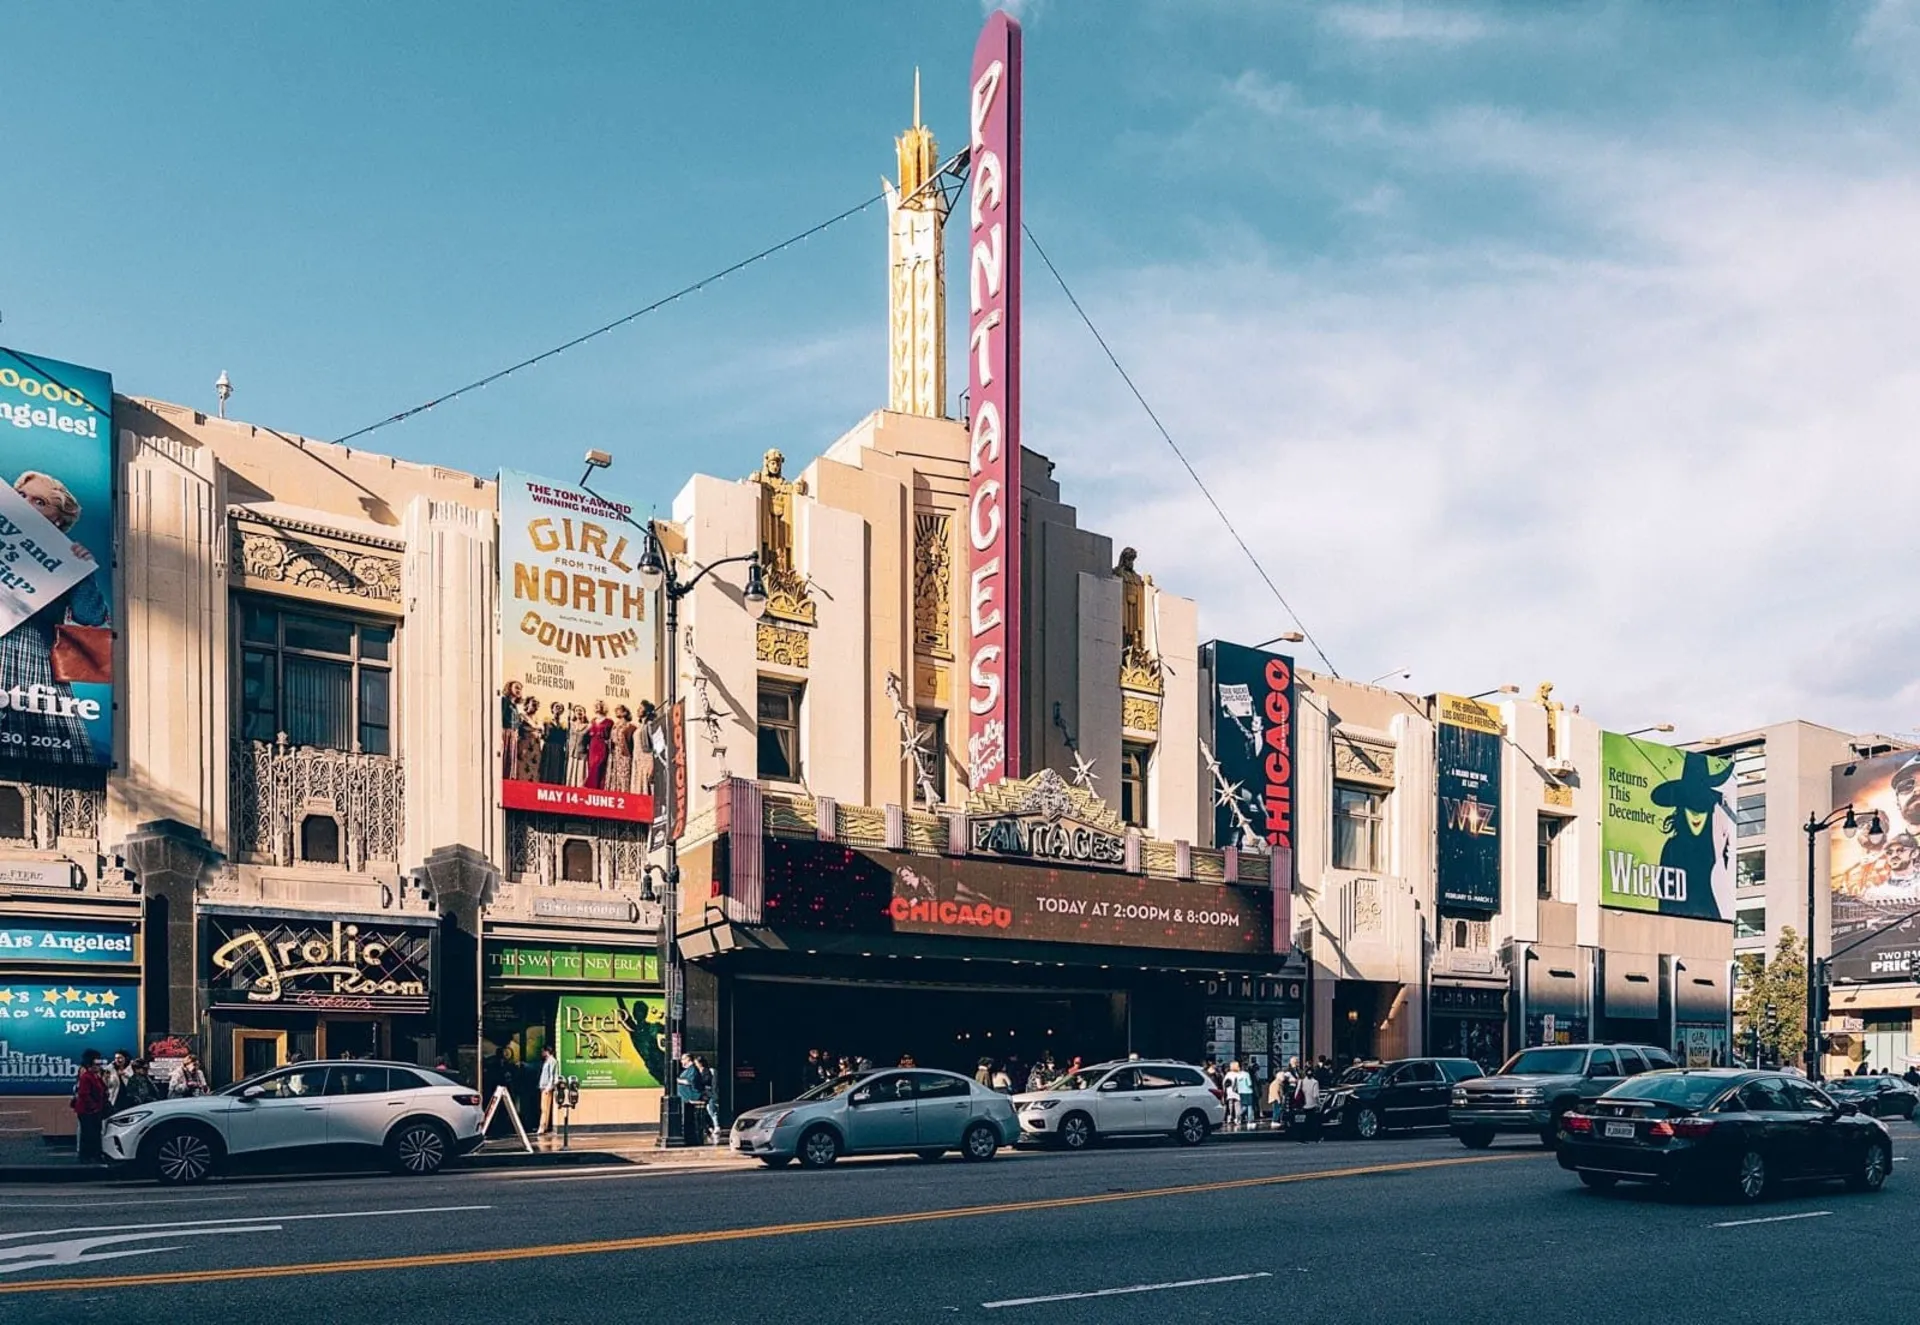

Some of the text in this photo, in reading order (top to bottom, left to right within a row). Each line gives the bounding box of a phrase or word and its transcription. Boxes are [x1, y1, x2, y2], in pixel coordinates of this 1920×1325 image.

[970, 60, 1002, 715] PANTAGES
[526, 483, 632, 514] THE TONY-AWARD
[532, 494, 630, 522] WINNING MUSICAL
[20, 538, 63, 573] and
[527, 517, 633, 574] GIRL
[554, 557, 608, 575] FROM THE
[514, 562, 645, 622] NORTH
[520, 611, 639, 659] COUNTRY
[536, 662, 564, 677] CONOR
[609, 673, 626, 687] BOB
[525, 673, 575, 691] McPHERSON
[605, 686, 630, 699] DYLAN
[1, 732, 72, 750] 30, 2024
[1609, 767, 1648, 789] Returns
[536, 789, 563, 804] MAY
[617, 795, 625, 809] 2
[1609, 785, 1631, 803] This
[1609, 803, 1656, 825] December
[973, 818, 1125, 864] PANTAGES
[890, 896, 1012, 929] CHICAGO
[1036, 897, 1240, 927] TODAY AT 2:00PM & 8:00PM
[39, 933, 132, 953] Angeles!
[213, 921, 386, 1001] Frolic
[489, 953, 525, 966] THIS
[528, 954, 557, 967] WAY
[1877, 951, 1901, 960] TWO
[1871, 960, 1911, 973] PRIC
[330, 966, 424, 995] Room
[1208, 980, 1300, 998] DINING
[60, 1008, 127, 1025] complete
